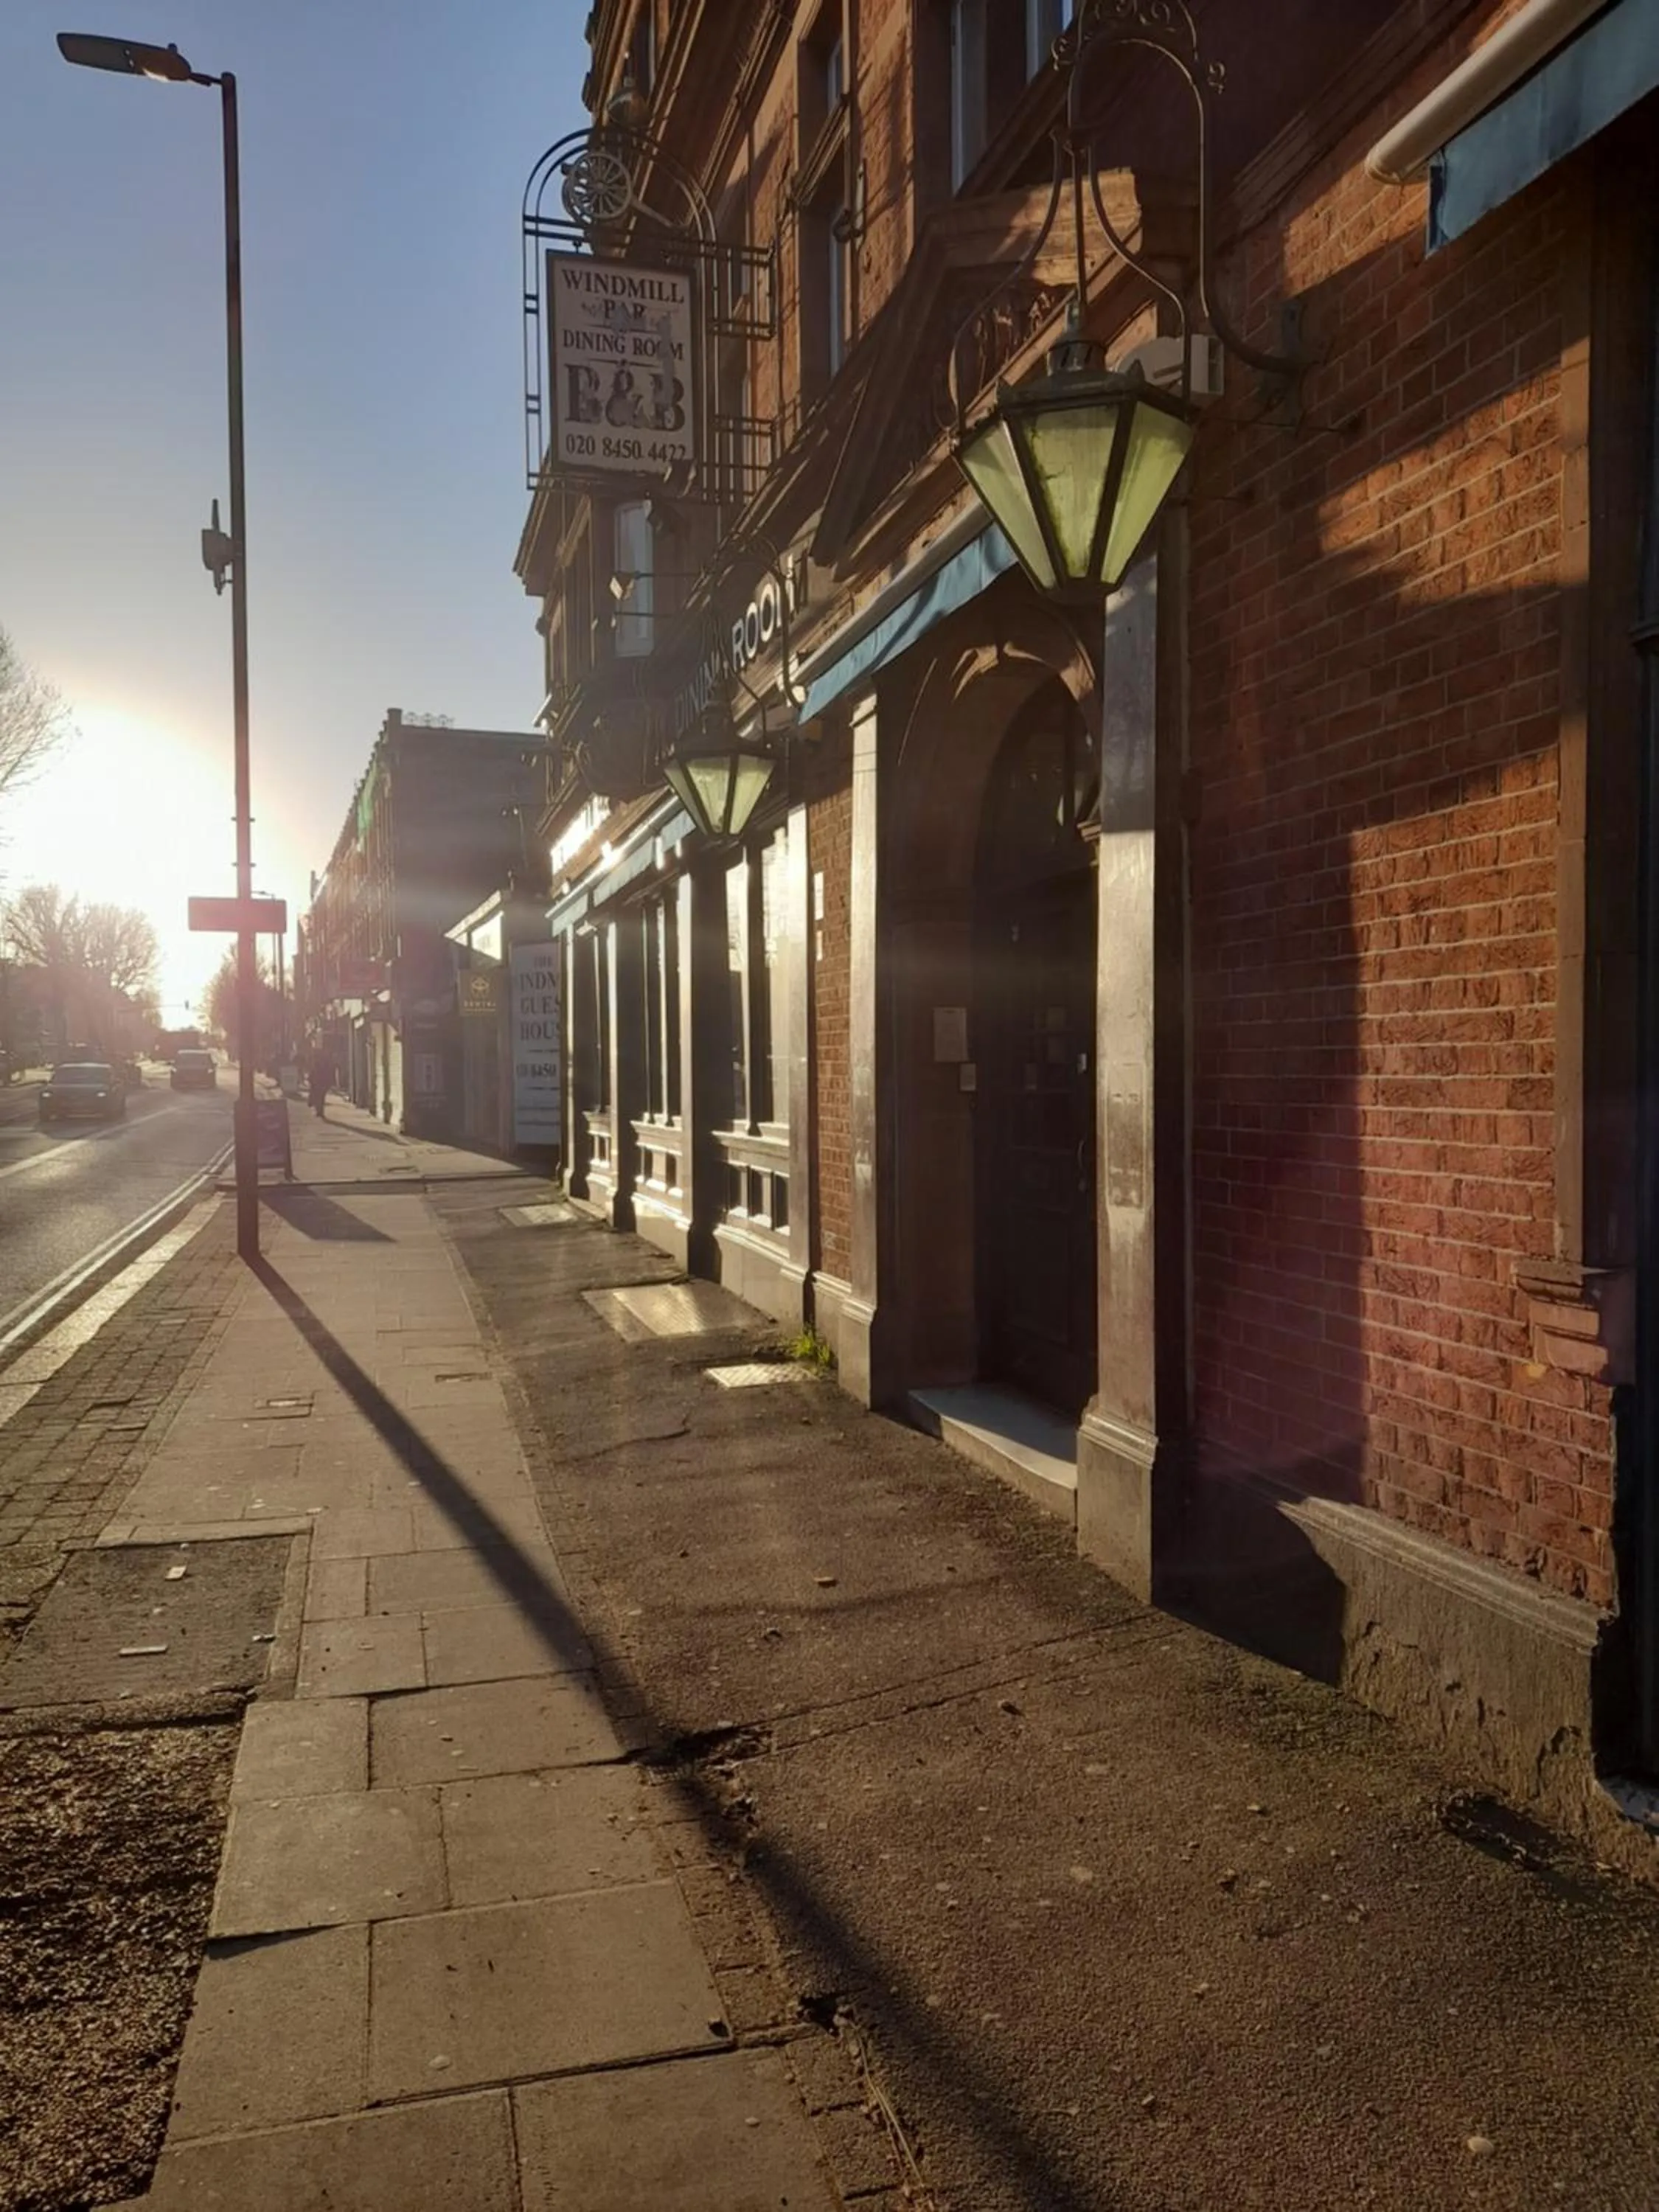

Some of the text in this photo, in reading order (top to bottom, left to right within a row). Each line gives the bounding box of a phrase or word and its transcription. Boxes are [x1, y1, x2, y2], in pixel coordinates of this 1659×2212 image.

[561, 268, 684, 304] WINDMILL
[563, 329, 625, 354] DINING
[566, 434, 596, 455] 020
[602, 437, 642, 460] 8450
